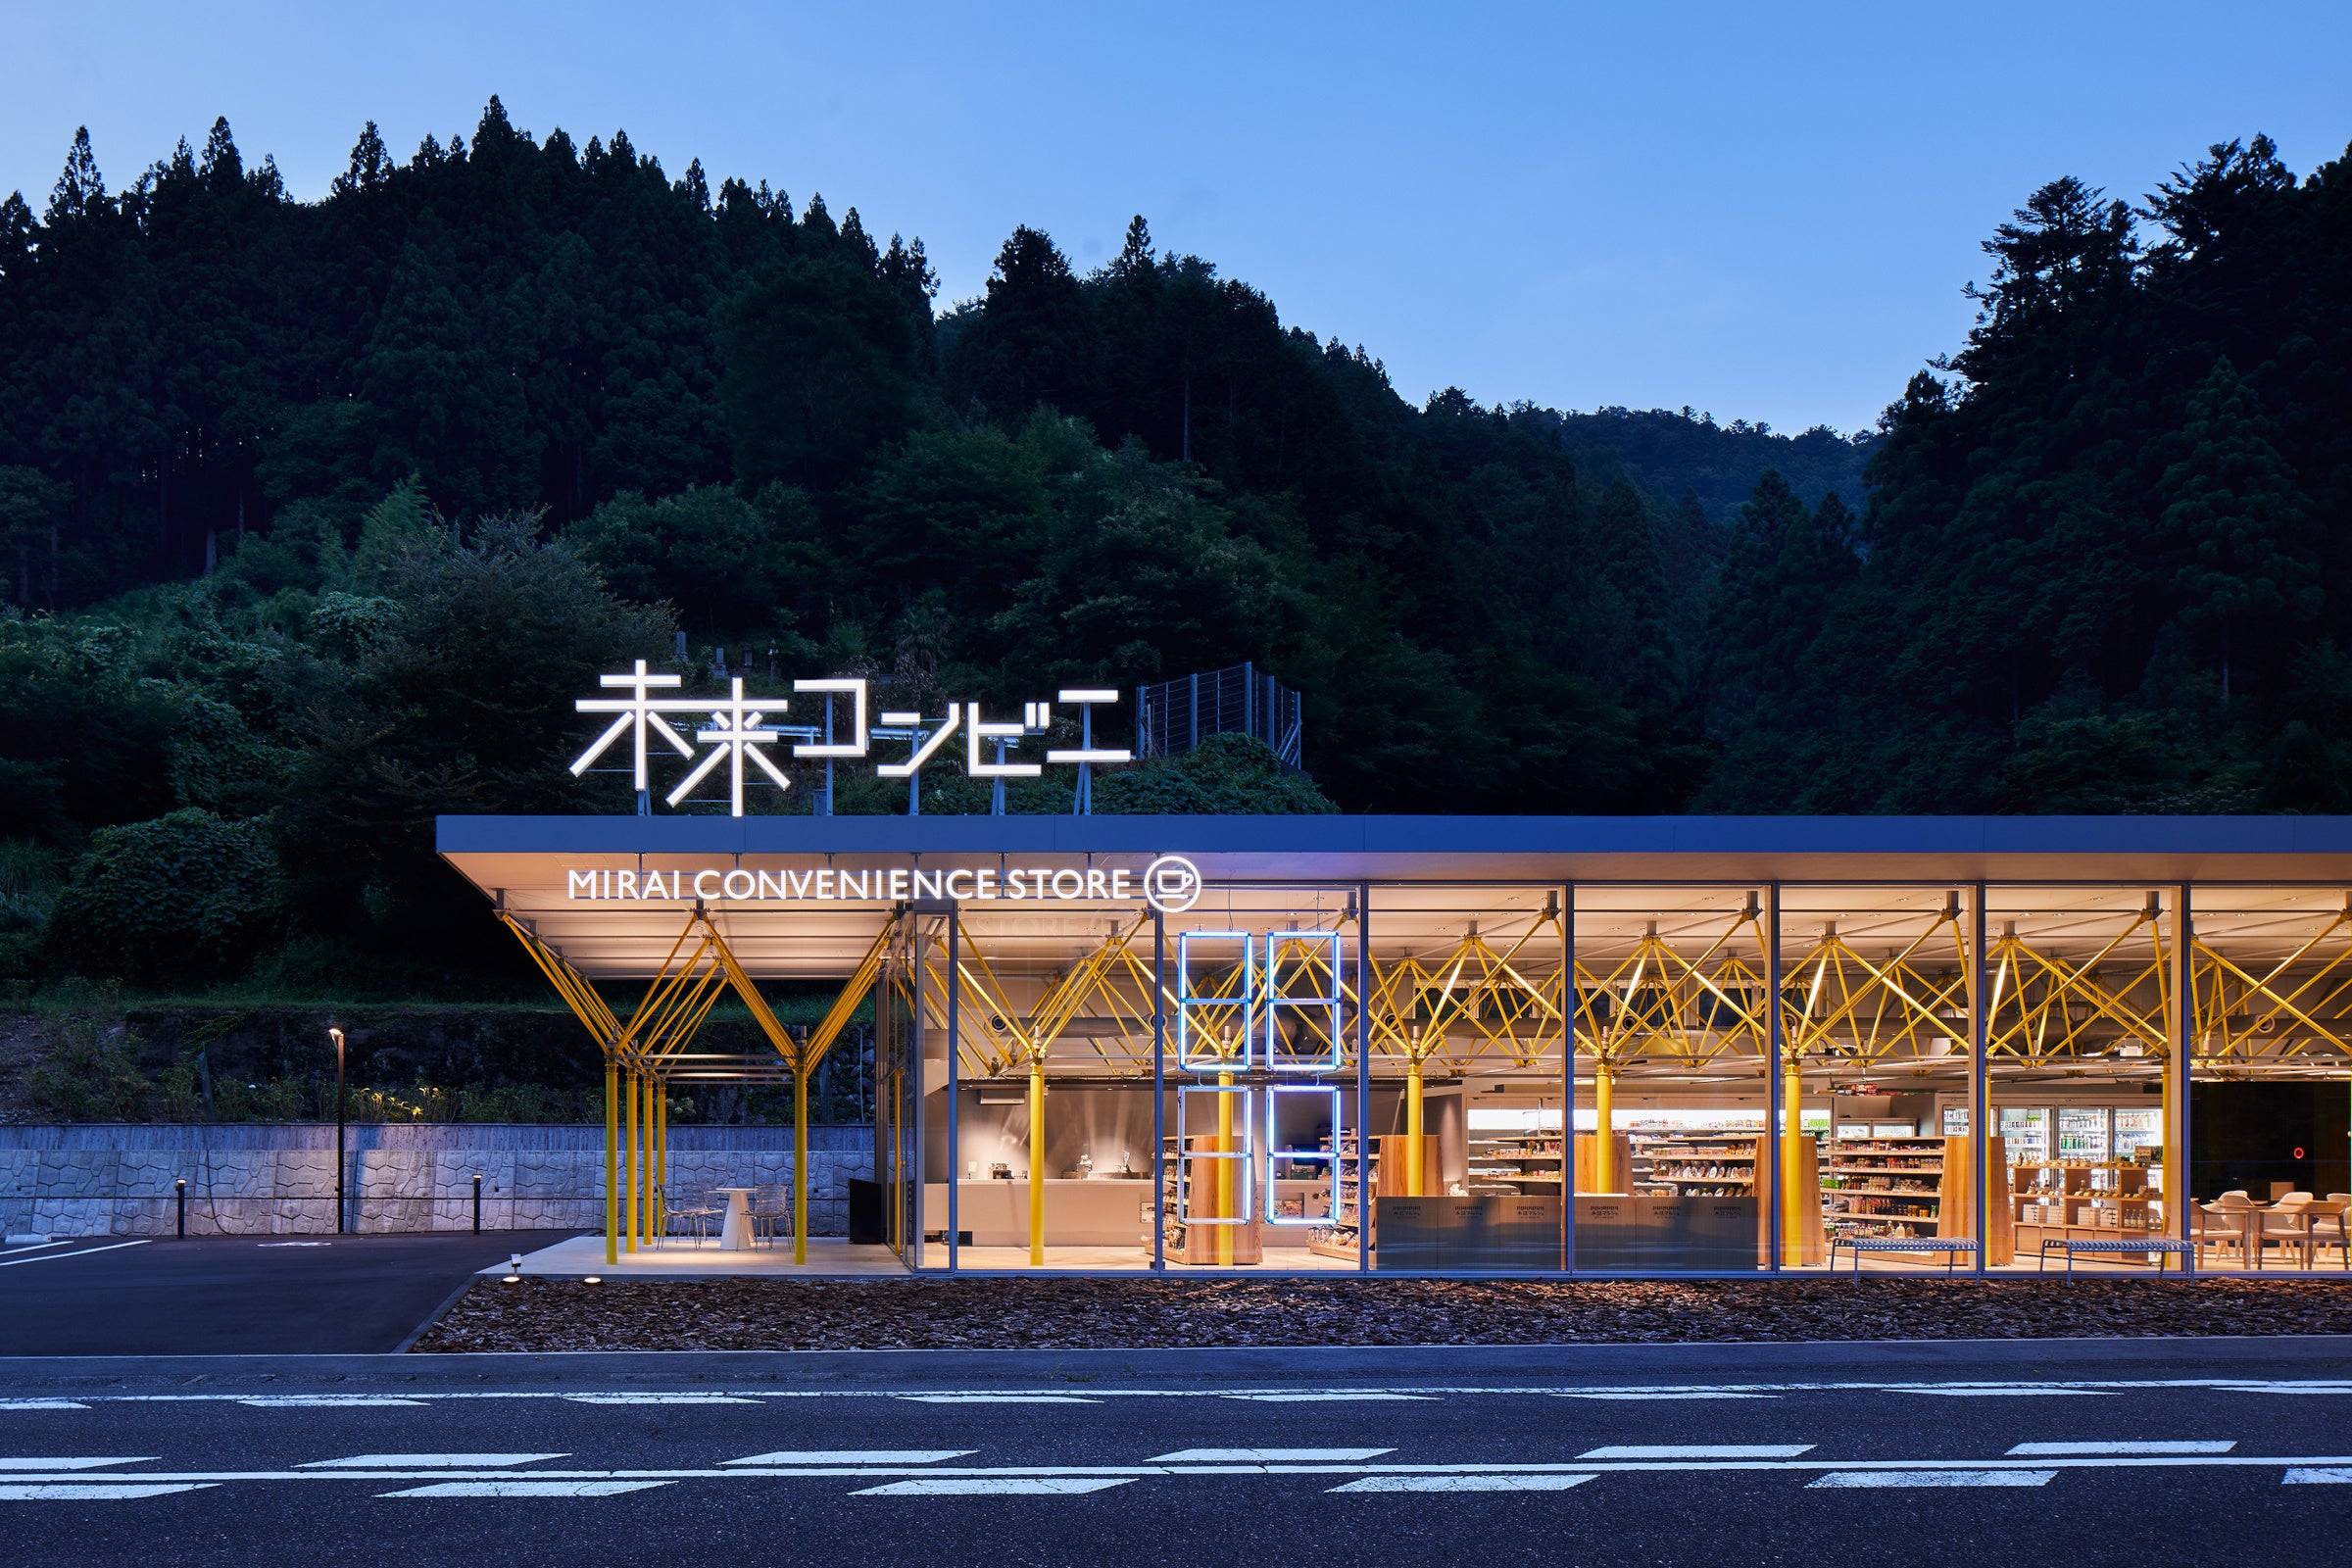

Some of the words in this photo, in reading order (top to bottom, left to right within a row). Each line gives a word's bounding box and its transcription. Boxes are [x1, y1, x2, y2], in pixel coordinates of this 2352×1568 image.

[568, 659, 1131, 816] 未来コンビニ
[568, 868, 680, 901] MIRAI
[693, 868, 996, 901] CONVENIENCE
[1008, 868, 1131, 901] STORE
